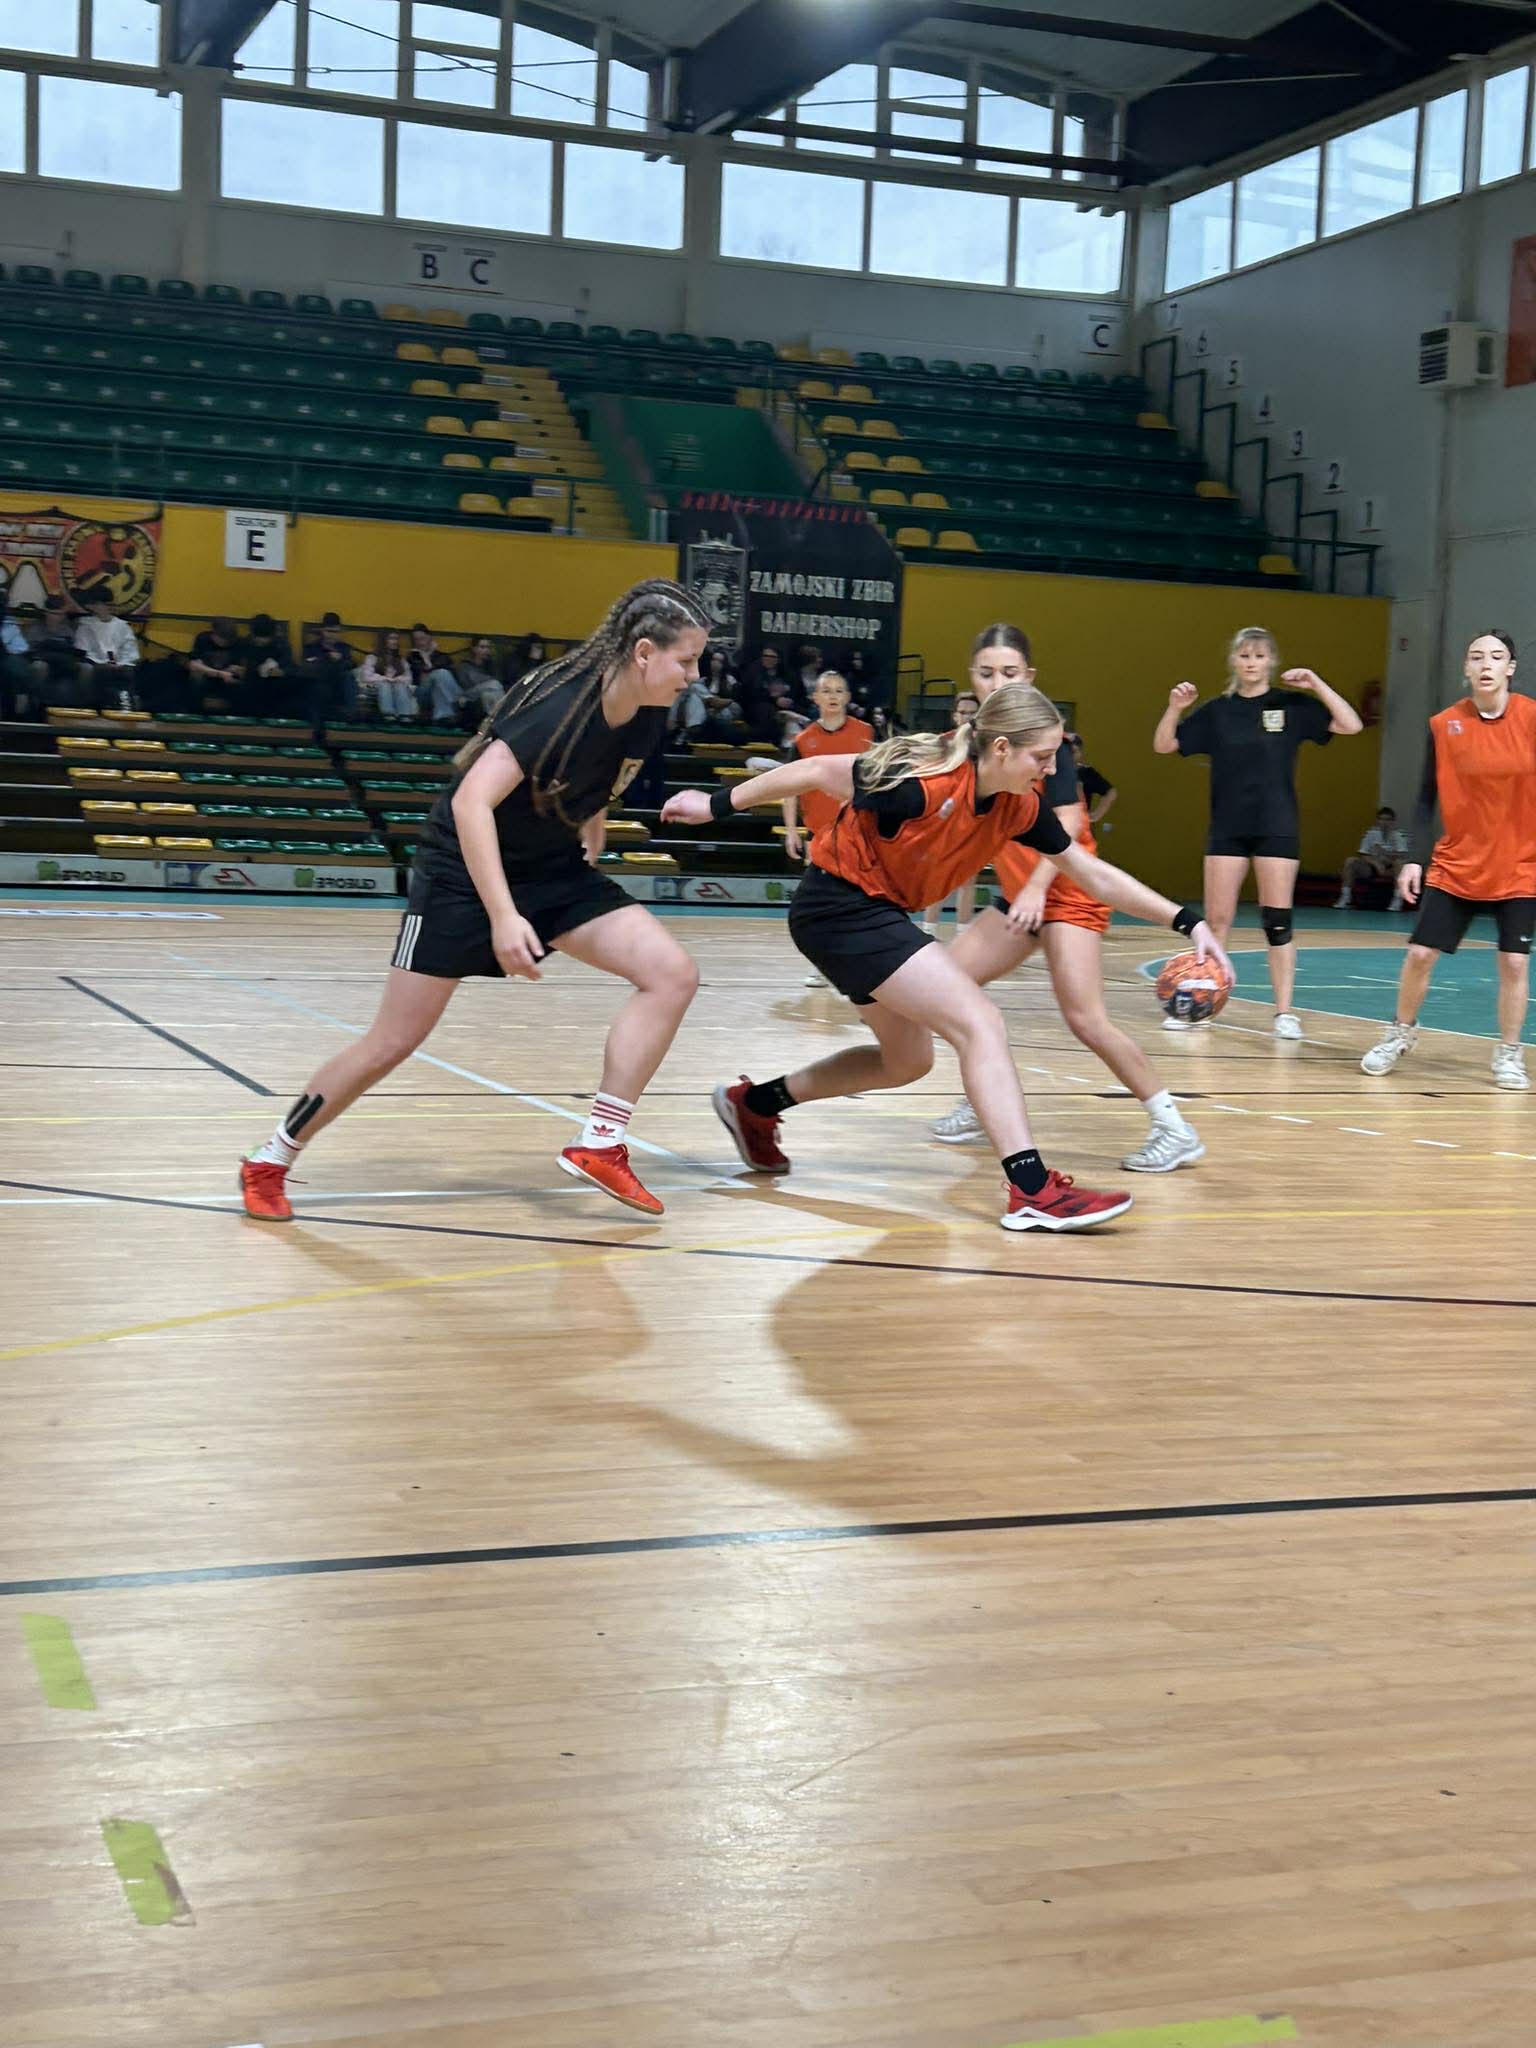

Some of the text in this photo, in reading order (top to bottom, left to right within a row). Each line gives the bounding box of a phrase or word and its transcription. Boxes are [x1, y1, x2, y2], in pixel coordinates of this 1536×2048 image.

[421, 253, 489, 285] B C
[1093, 324, 1111, 348] C
[1227, 360, 1239, 385] 5
[1292, 430, 1303, 456] 3
[1327, 462, 1340, 489] 2
[1365, 501, 1374, 528] 1
[246, 529, 266, 561] E
[750, 571, 846, 599] ZAMOJSKI
[760, 611, 882, 640] BARBERSHOP
